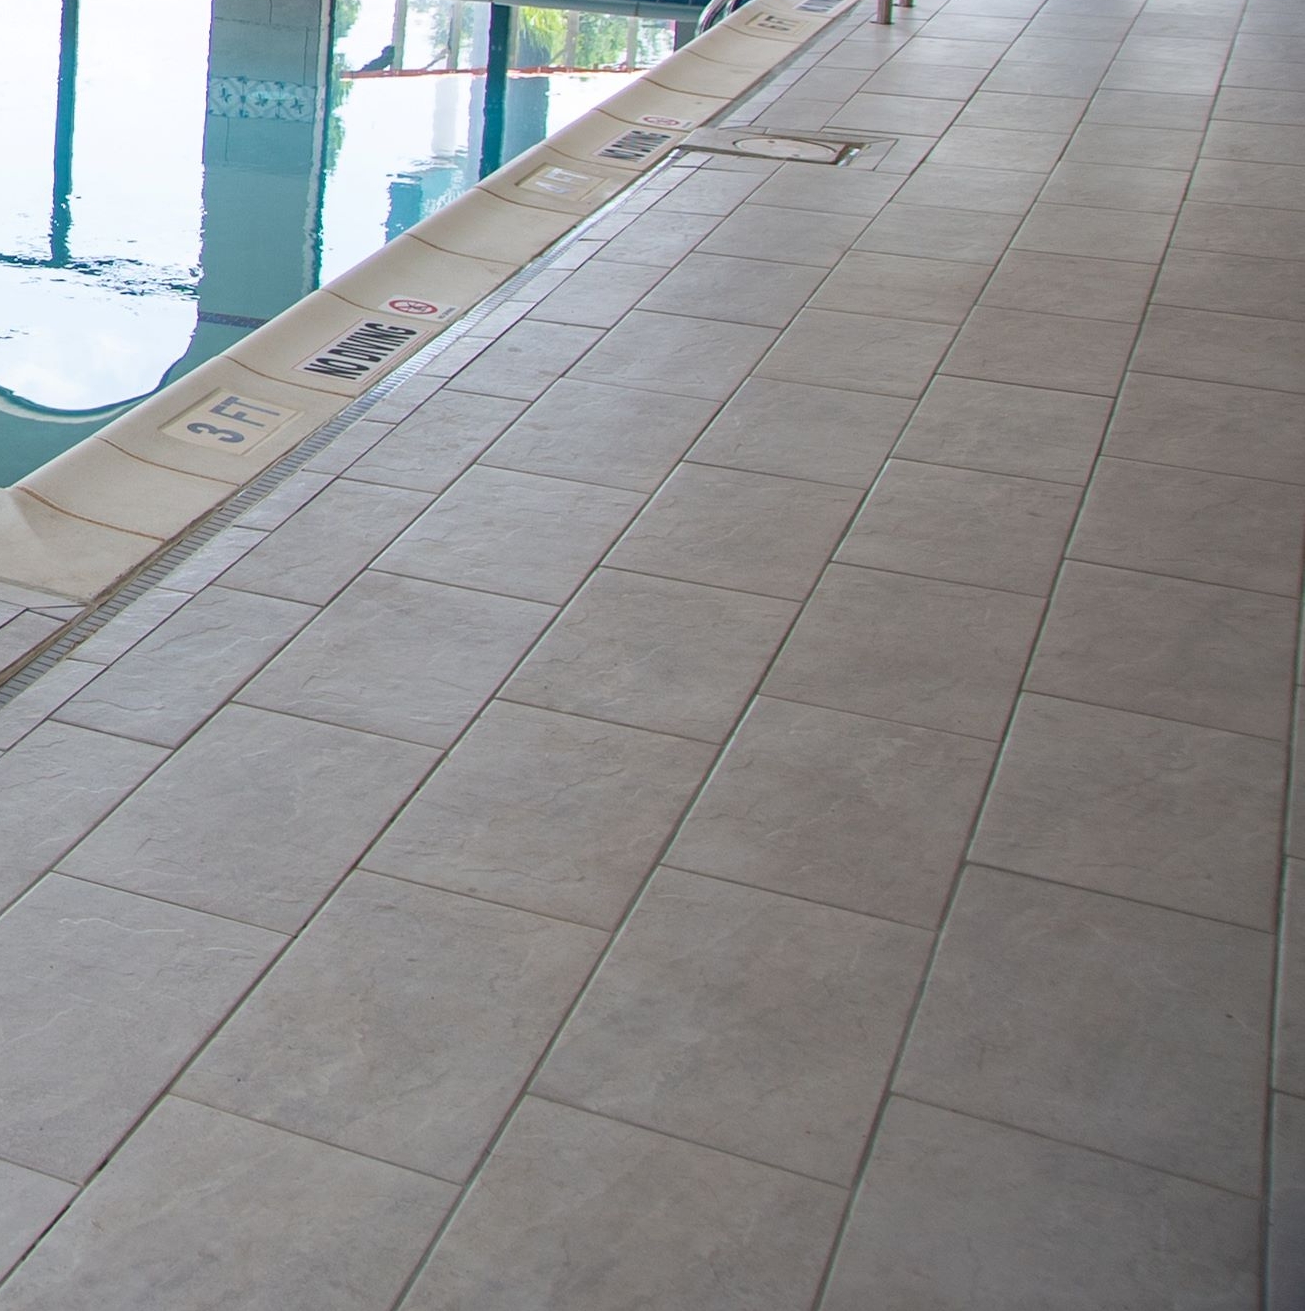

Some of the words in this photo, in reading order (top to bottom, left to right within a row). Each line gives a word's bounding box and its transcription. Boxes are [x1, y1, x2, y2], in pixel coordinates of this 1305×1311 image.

[337, 322, 418, 364] DIVING
[304, 358, 372, 380] NO
[210, 395, 284, 428] FT
[187, 422, 245, 444] 3
